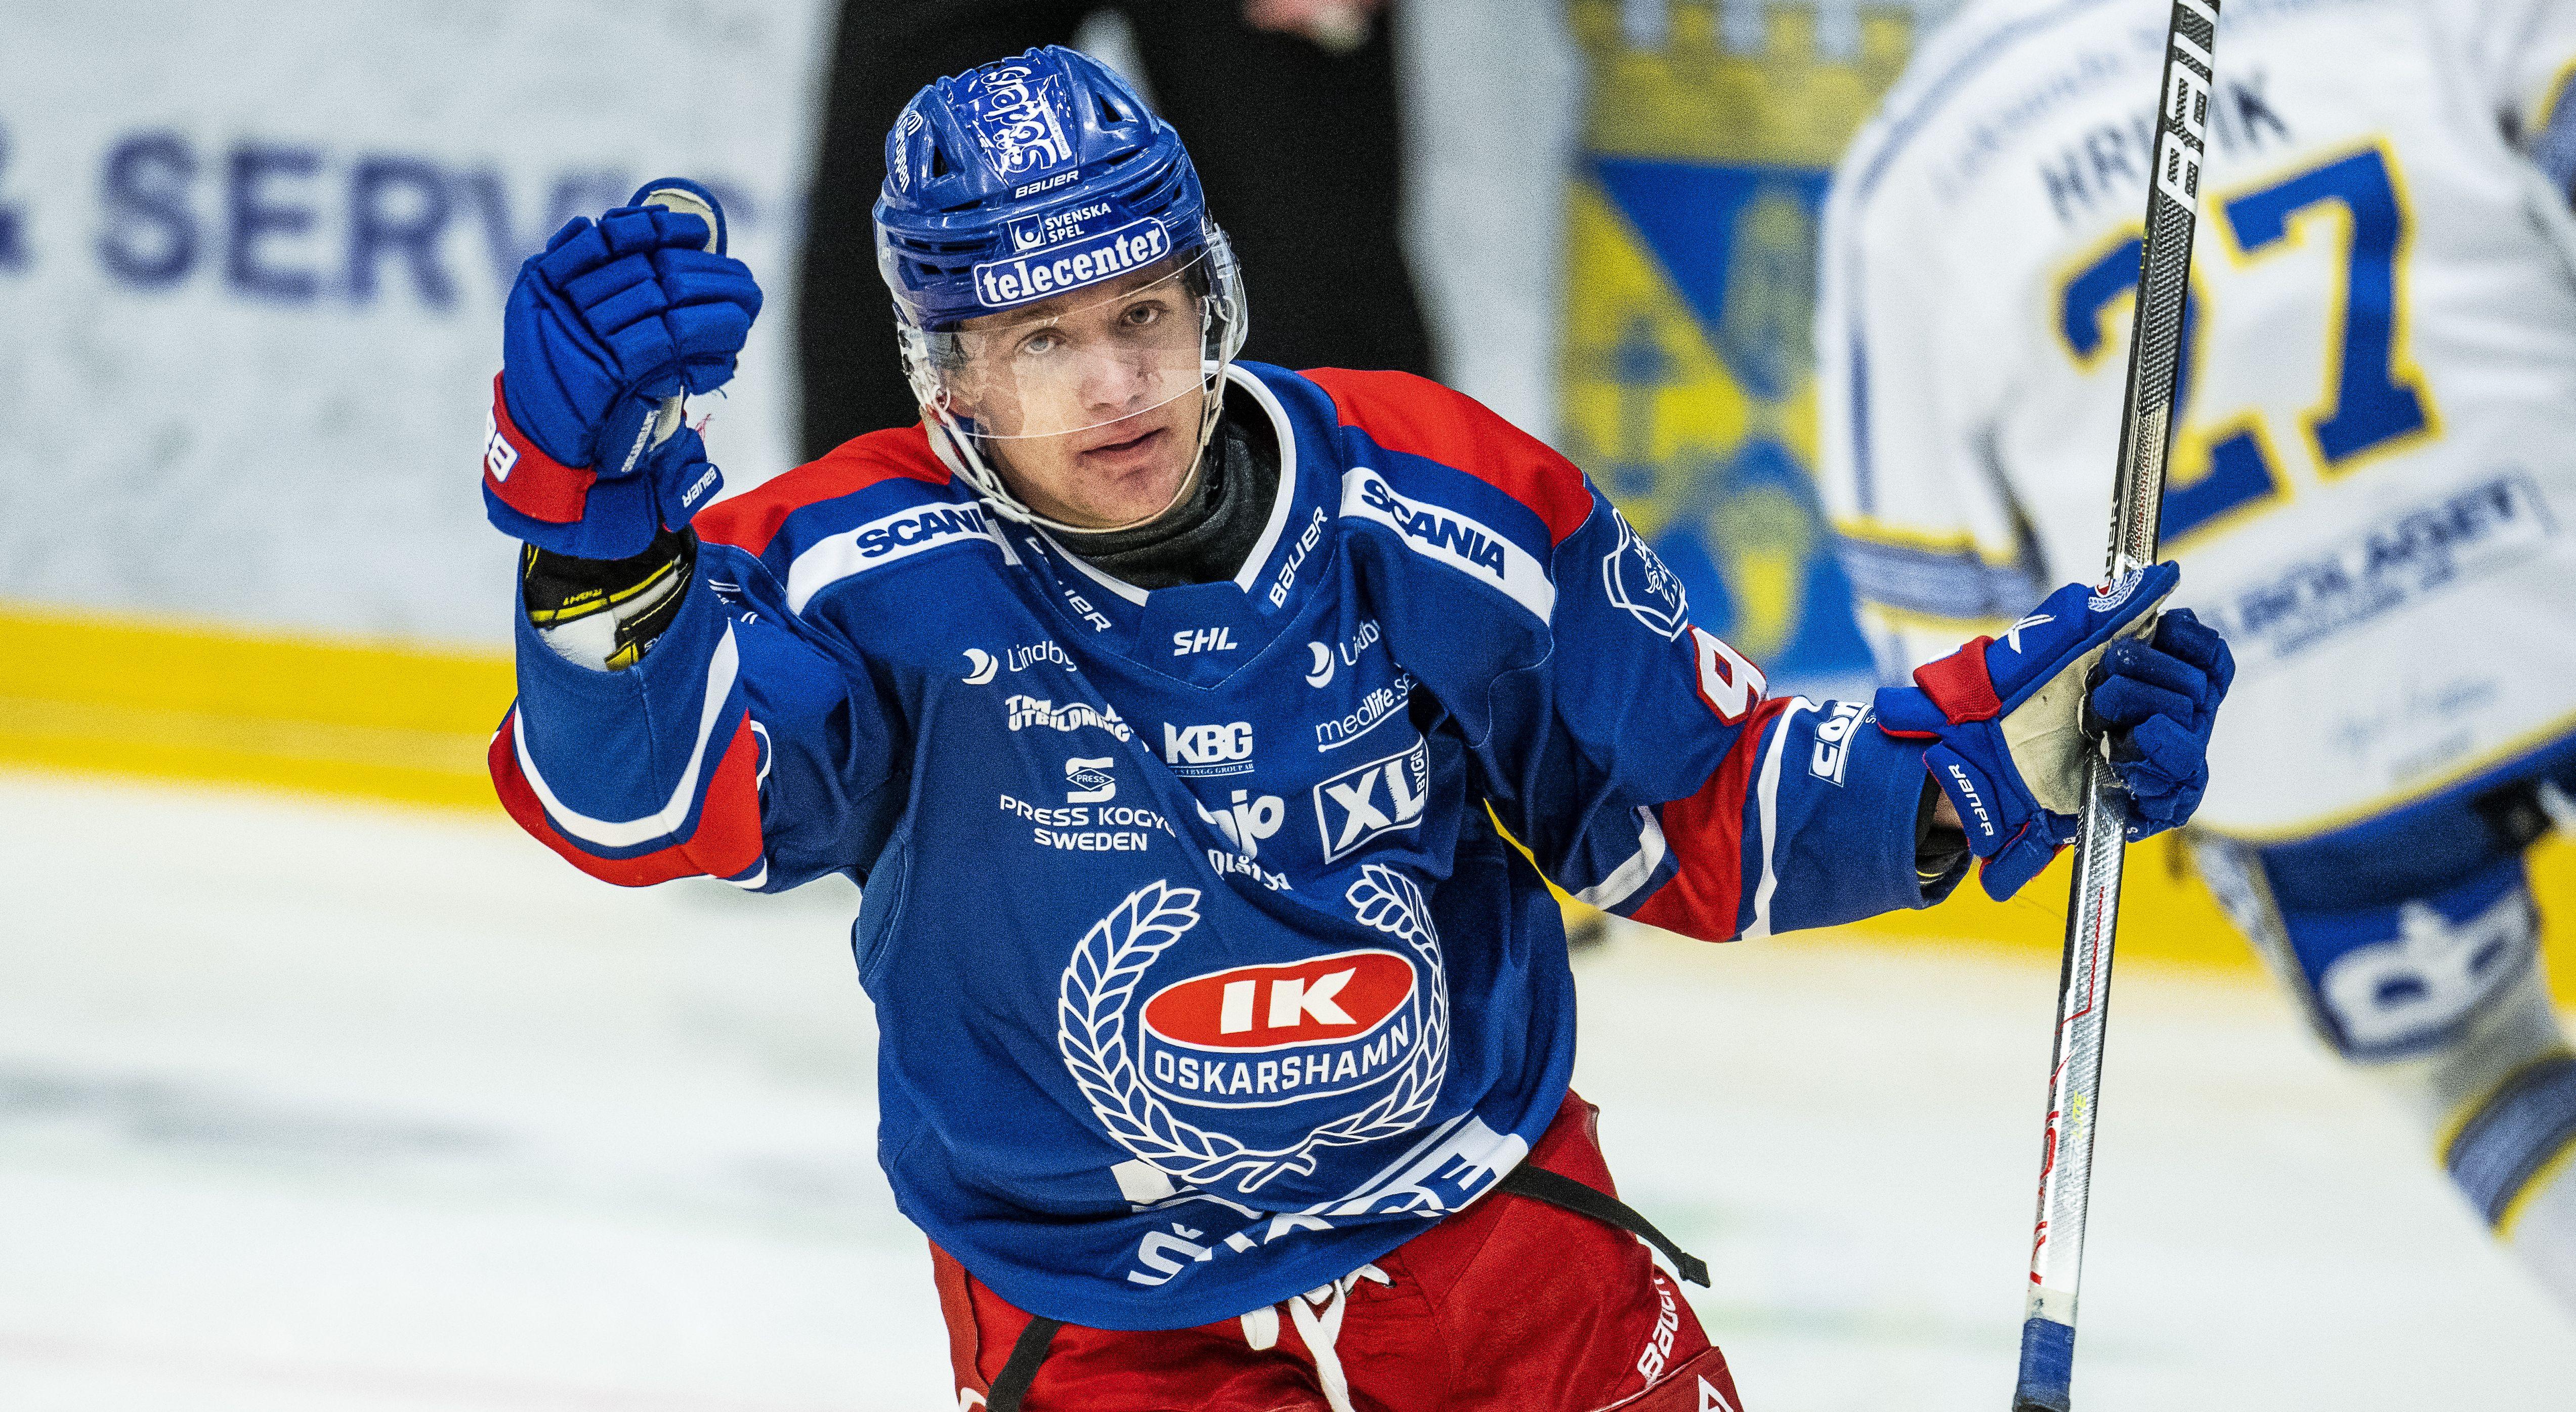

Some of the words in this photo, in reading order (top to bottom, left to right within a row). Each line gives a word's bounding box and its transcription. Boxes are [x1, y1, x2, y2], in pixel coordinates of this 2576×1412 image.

[1015, 170, 1079, 199] BAUER
[1044, 202, 1112, 230] SVENSKA
[1048, 224, 1085, 243] SPEL
[983, 227, 1162, 303] telecenter
[856, 505, 990, 558] SCANI
[1361, 478, 1505, 580] SCANIA
[1269, 506, 1328, 608] BAUER
[1173, 626, 1238, 656] SHL
[1164, 721, 1253, 764] KBG
[1076, 774, 1105, 784] PRESS
[1215, 764, 1243, 774] GROUP
[1410, 749, 1425, 793] BYGG
[1000, 795, 1089, 826] PRESS
[1325, 759, 1425, 852] XL
[1948, 764, 1994, 836] BAUER
[1034, 827, 1147, 851] SWEDEN
[1220, 967, 1357, 1035] IK
[1155, 1014, 1410, 1095] OSKARSHAMN
